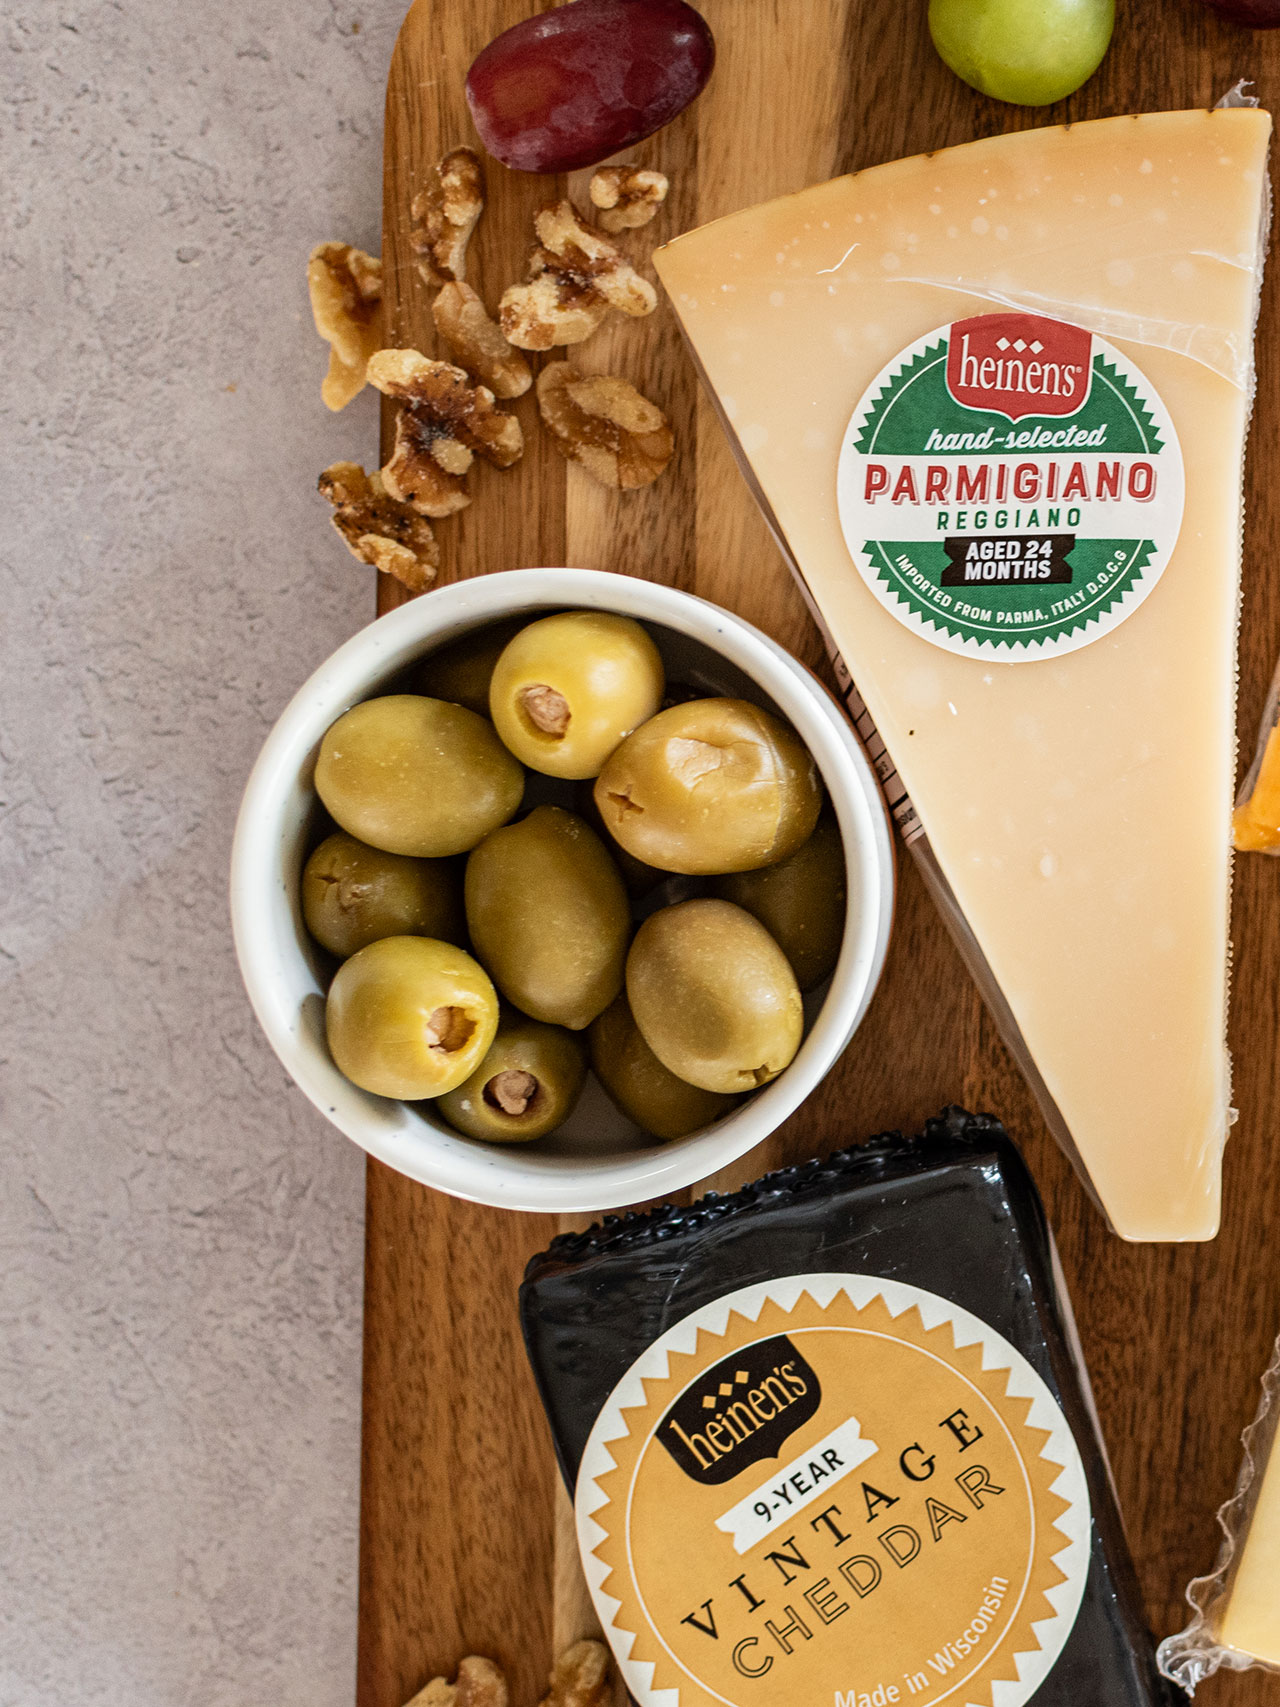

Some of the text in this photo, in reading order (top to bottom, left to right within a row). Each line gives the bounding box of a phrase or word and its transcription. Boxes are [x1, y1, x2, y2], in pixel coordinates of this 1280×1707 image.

[924, 424, 1108, 451] hand-selected
[864, 461, 1157, 505] PARMIGIANO
[937, 508, 1081, 530] REGGIANO
[964, 560, 1052, 580] MONTHS
[965, 540, 1053, 561] AGED 24
[895, 554, 952, 607] IMPORTED
[954, 601, 992, 623] FROM
[996, 609, 1049, 624] PARMA,
[1051, 592, 1087, 616] ITALY
[753, 1447, 845, 1522] 9-YEAR
[680, 1408, 984, 1642] VINTAGE
[732, 1464, 1006, 1678] CHEDDAR
[835, 1576, 1009, 1707] Made in Wisconsin
